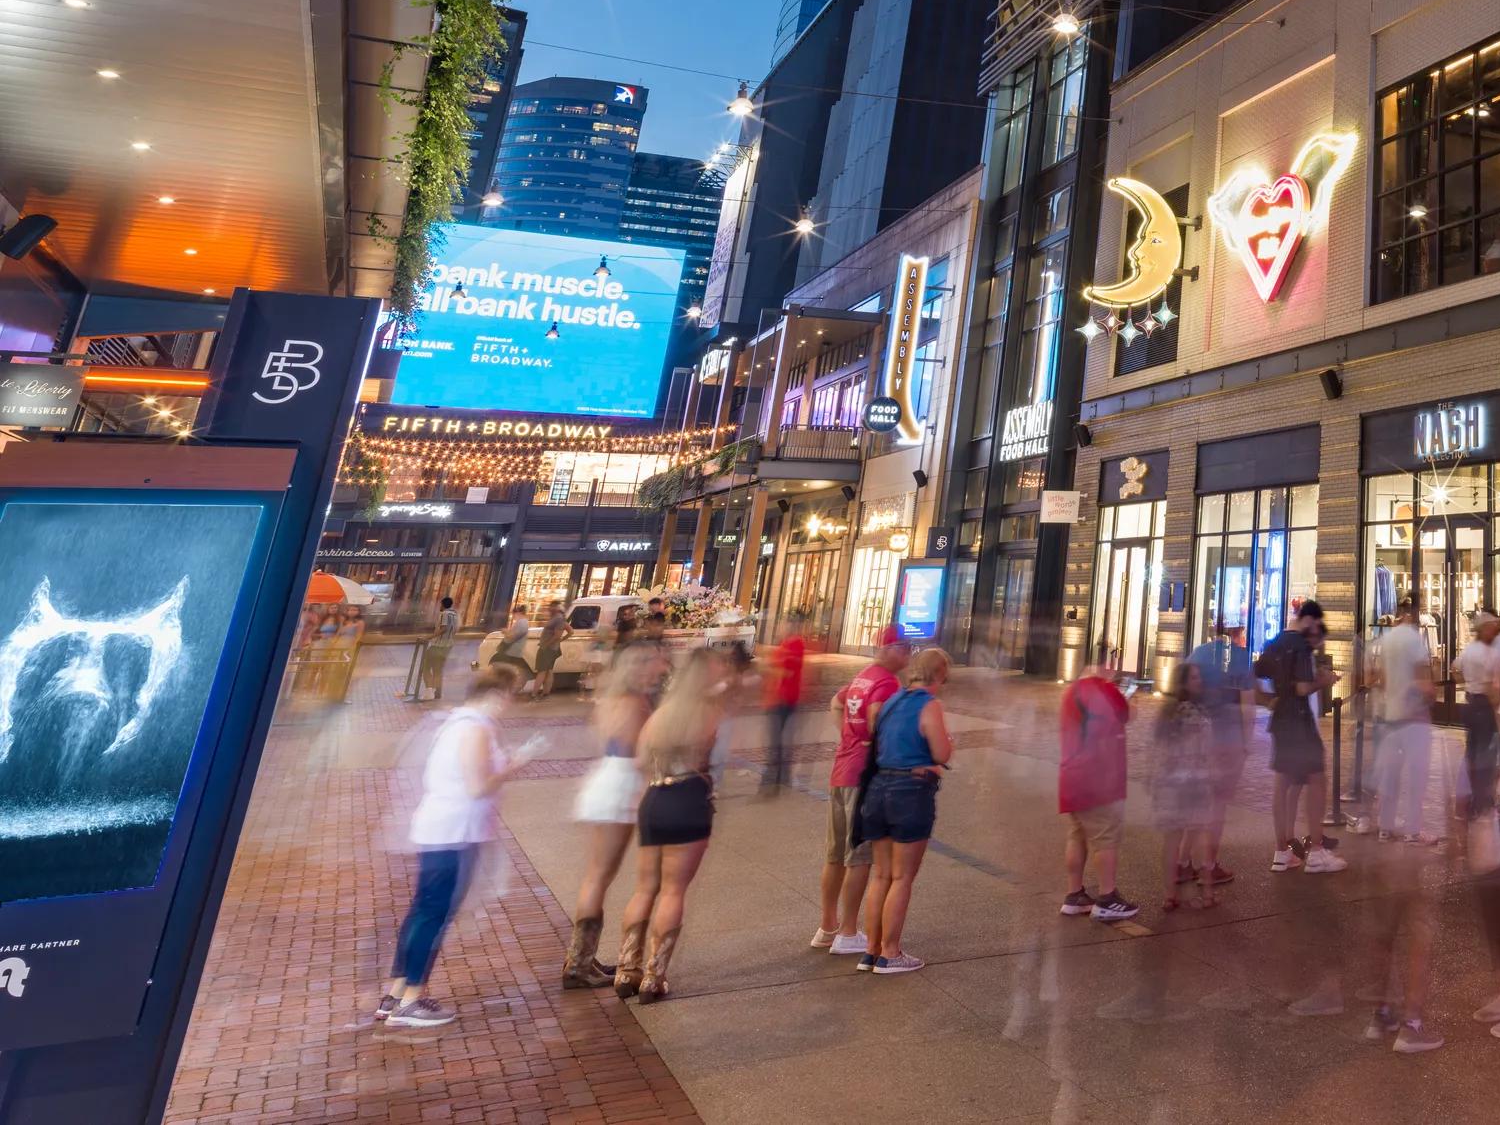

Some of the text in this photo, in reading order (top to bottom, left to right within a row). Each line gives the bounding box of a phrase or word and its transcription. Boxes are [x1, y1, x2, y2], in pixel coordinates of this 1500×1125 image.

[511, 271, 630, 301] muscle.
[455, 287, 535, 321] bank
[541, 297, 641, 330] hustle.
[894, 267, 918, 392] ASSEMBLY
[15, 379, 72, 400] Liberty
[19, 406, 68, 415] MENSWEAR
[871, 405, 898, 414] FOOD
[1437, 402, 1454, 410] THE
[384, 416, 460, 433] FIFTH
[483, 421, 611, 439] BROADWAY
[870, 414, 897, 424] HALL
[1002, 400, 1054, 445] ASSEMBLY
[1414, 405, 1483, 457] NASH
[1000, 437, 1049, 461] FOOD HALL
[354, 548, 395, 557] Access
[608, 542, 651, 551] ARIAT
[30, 939, 80, 950] PARTNER
